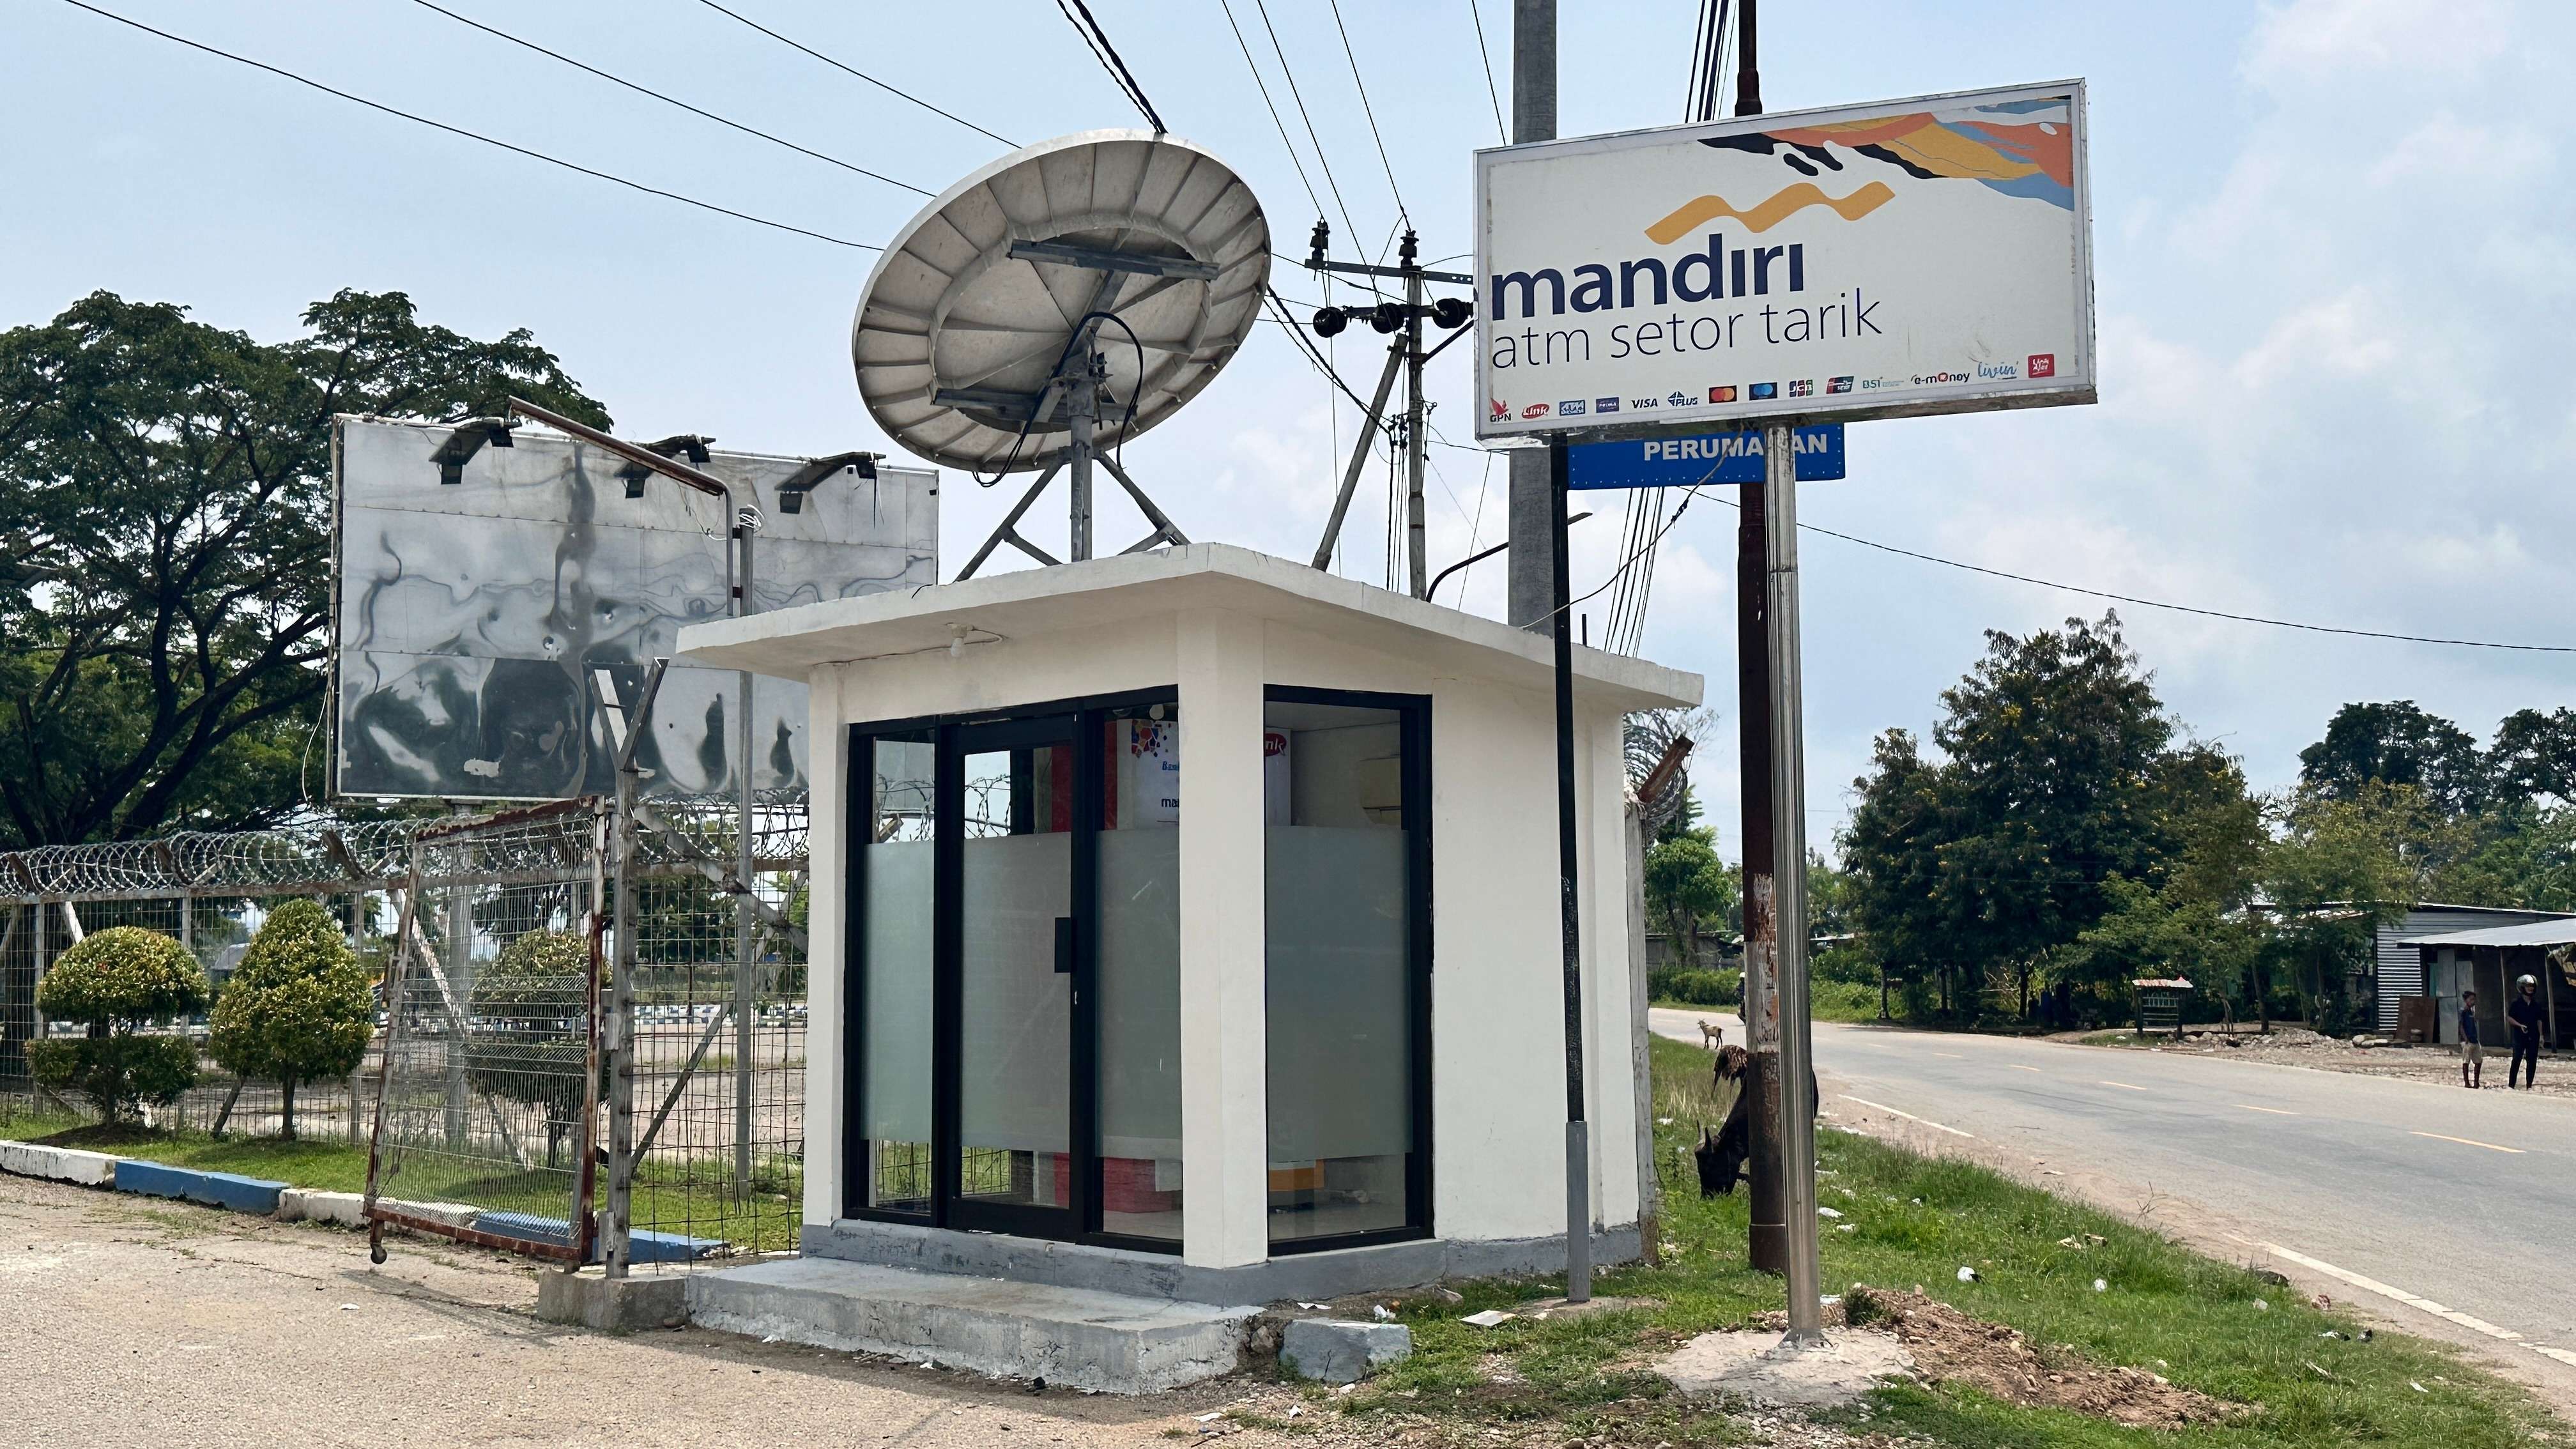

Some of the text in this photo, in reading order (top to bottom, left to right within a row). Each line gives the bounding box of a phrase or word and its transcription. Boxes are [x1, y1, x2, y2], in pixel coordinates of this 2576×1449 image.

[1492, 288, 1883, 369] atm setor tarik
[1862, 379, 1880, 389] BSI
[1631, 398, 1659, 409] VISA
[1675, 397, 1698, 407] PLUS
[1490, 413, 1512, 422] GPN
[1644, 434, 1827, 461] PERUMAAN
